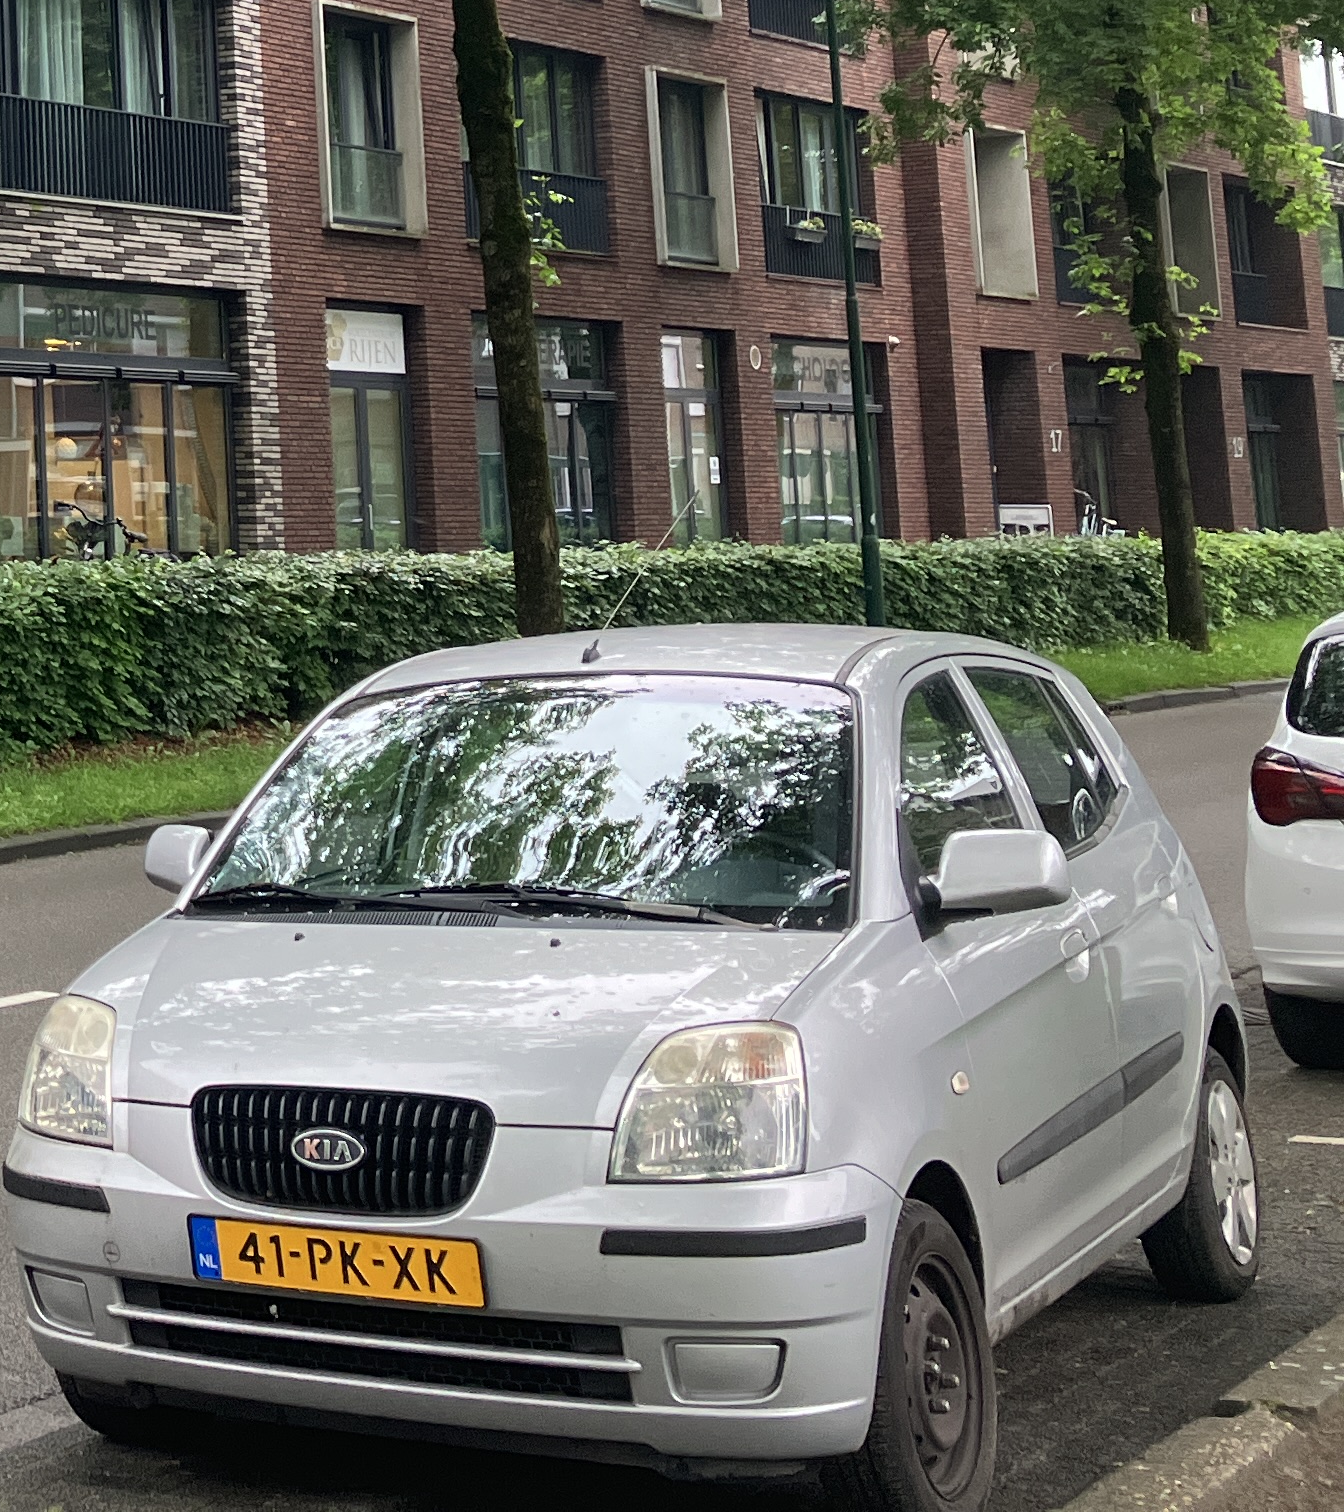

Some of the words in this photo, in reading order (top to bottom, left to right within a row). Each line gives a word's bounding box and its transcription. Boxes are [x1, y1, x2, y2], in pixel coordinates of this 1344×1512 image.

[53, 303, 156, 341] PEDICURE
[349, 338, 397, 368] RIJEN
[1050, 429, 1062, 453] 17
[1232, 437, 1243, 458] 19
[303, 1137, 353, 1163] KIA
[198, 1252, 219, 1270] NL
[237, 1231, 458, 1296] 41-PK-XK
